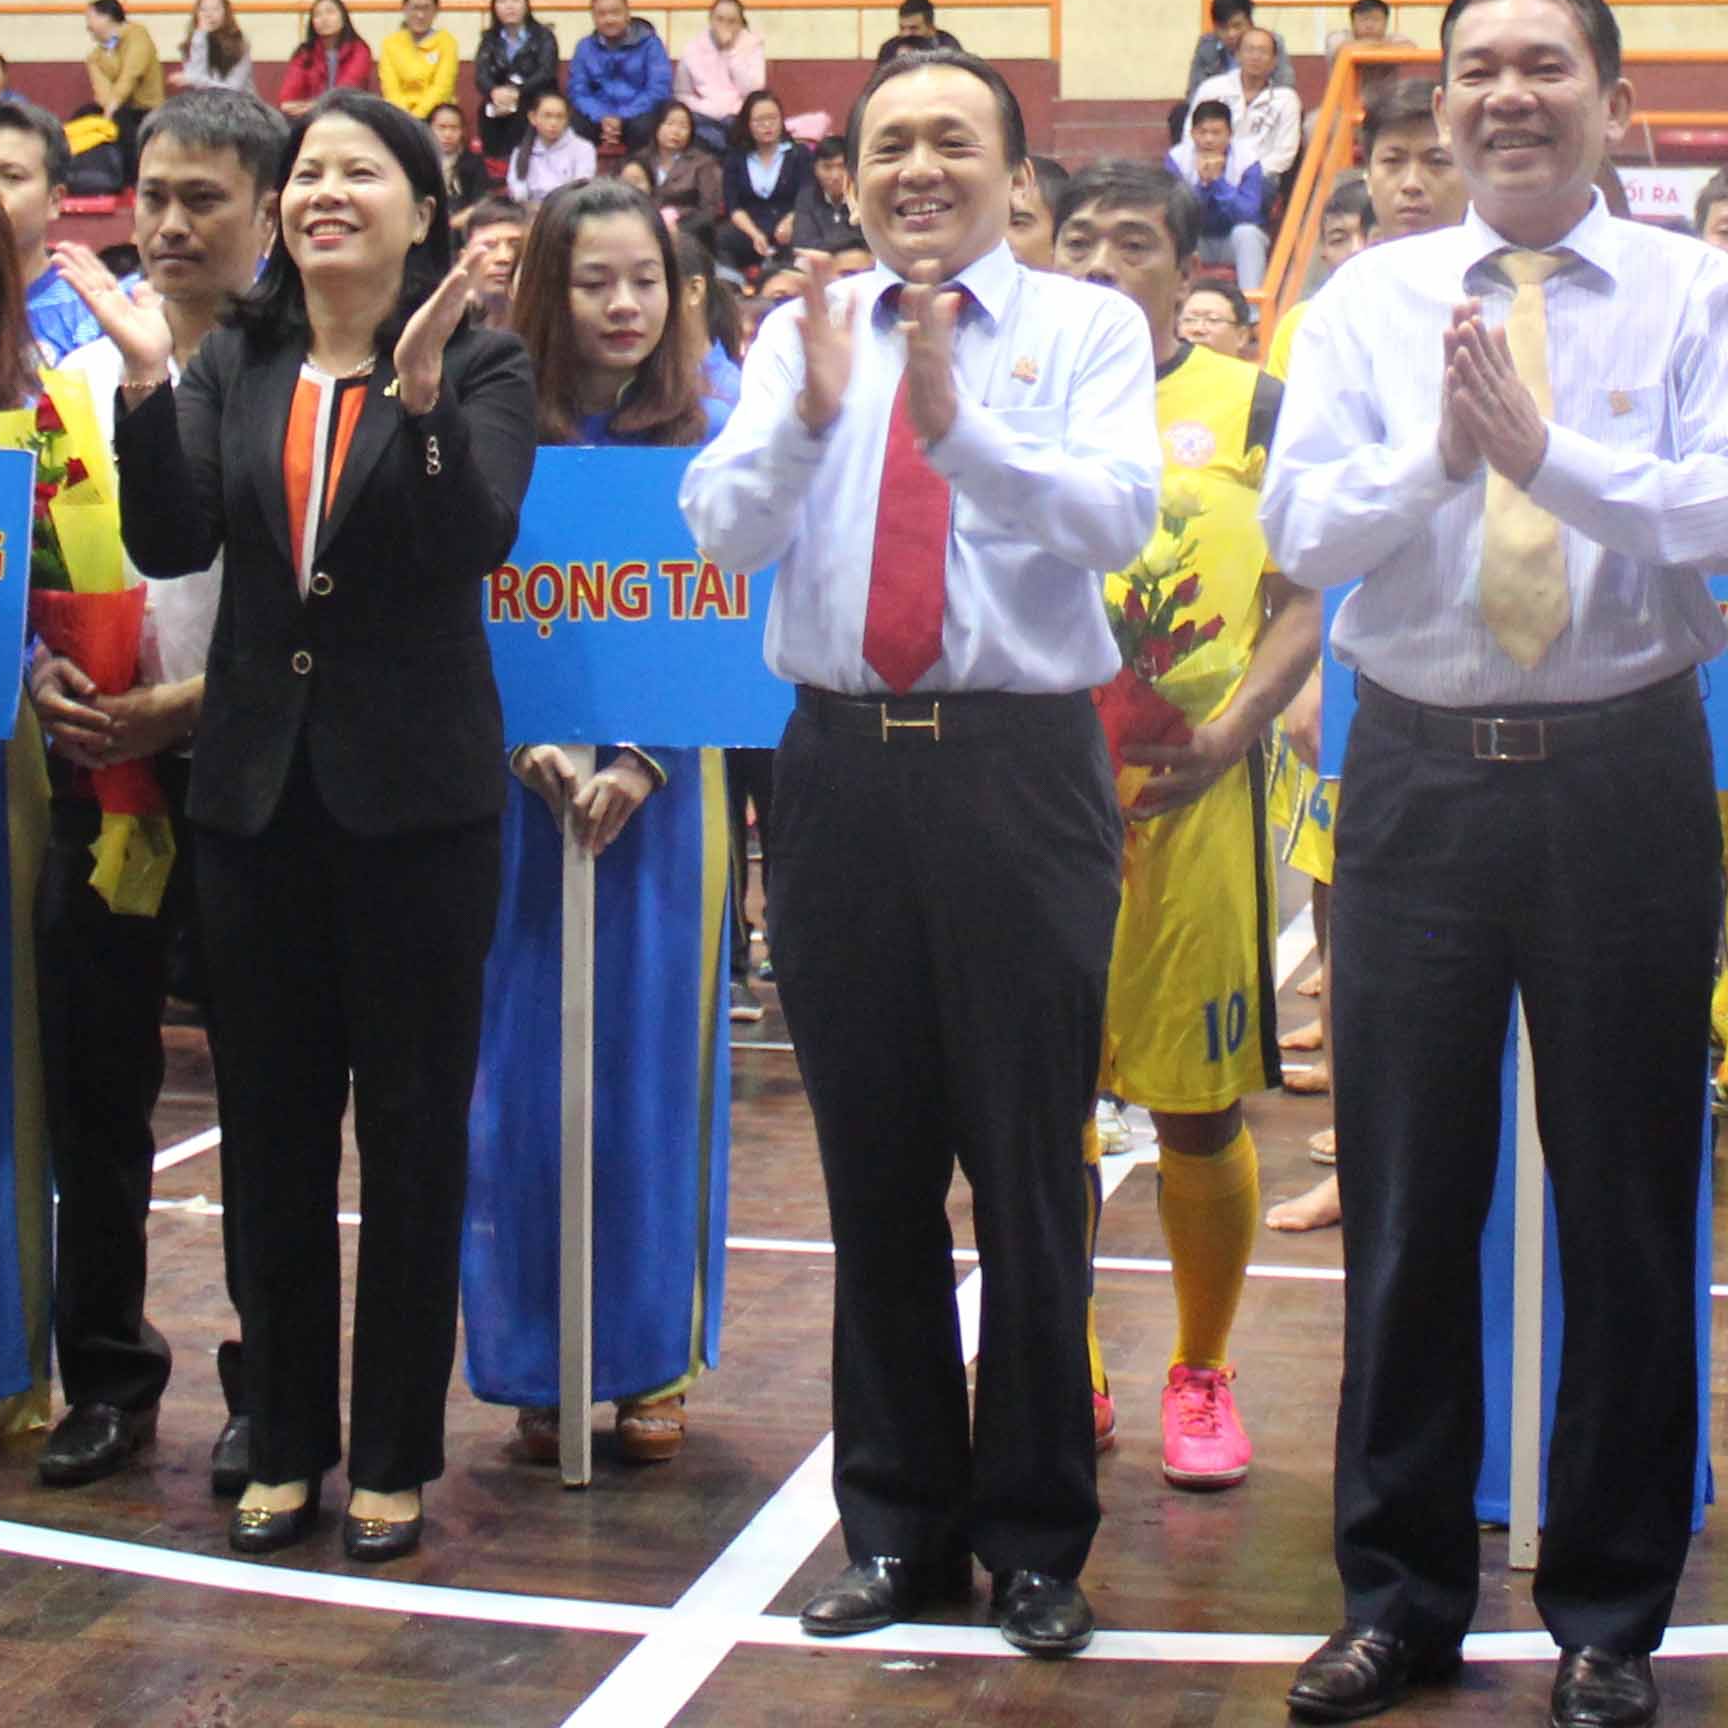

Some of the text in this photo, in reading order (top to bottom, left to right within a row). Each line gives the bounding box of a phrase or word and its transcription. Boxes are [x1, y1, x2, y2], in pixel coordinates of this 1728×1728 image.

[1652, 188, 1680, 203] RA
[482, 559, 651, 639] RỌNG
[1204, 991, 1247, 1063] 10
